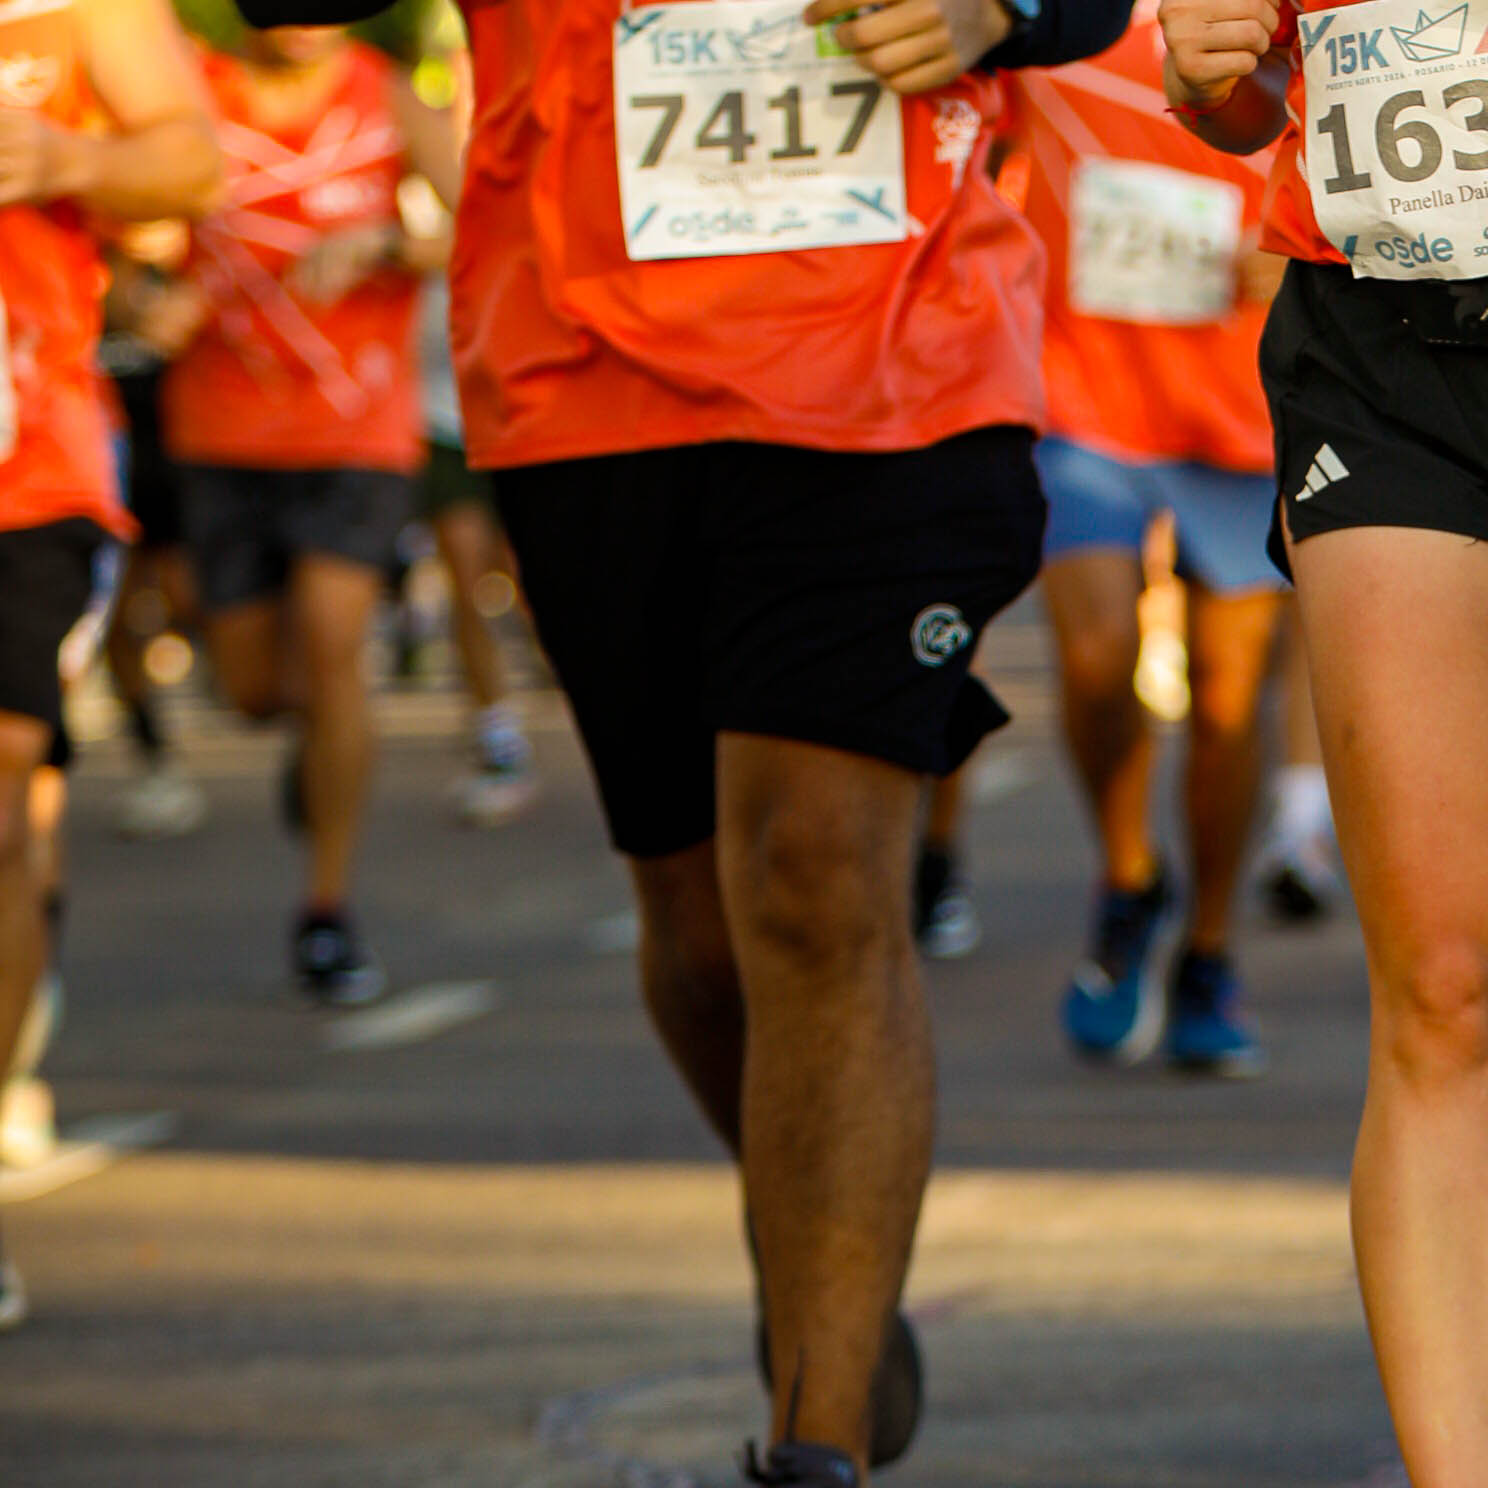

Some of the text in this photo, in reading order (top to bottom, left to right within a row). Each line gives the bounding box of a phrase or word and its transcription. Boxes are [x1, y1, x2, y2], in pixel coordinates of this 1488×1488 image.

[649, 28, 718, 65] 15K
[1324, 28, 1390, 76] 15K
[628, 81, 884, 169] 7417
[1390, 191, 1454, 215] Panella
[1375, 232, 1454, 268] osde
